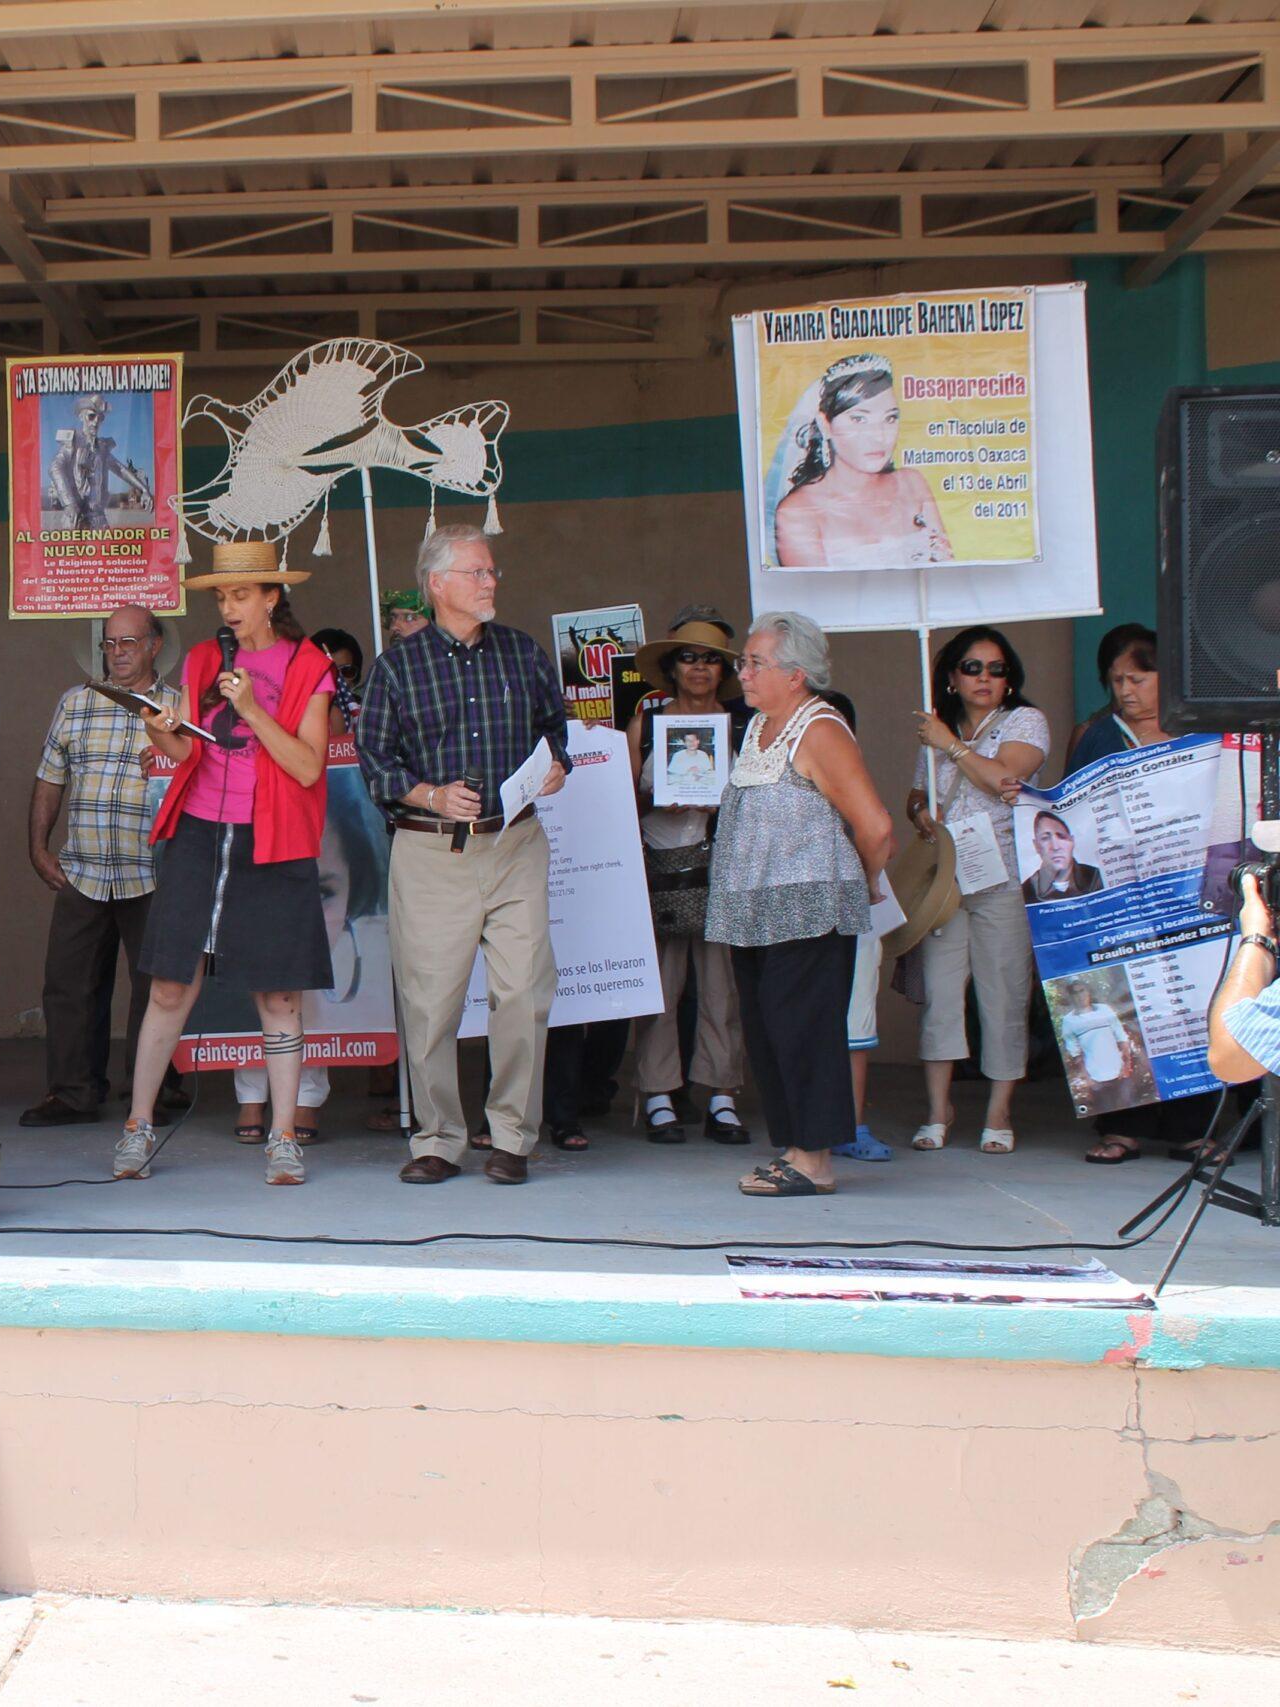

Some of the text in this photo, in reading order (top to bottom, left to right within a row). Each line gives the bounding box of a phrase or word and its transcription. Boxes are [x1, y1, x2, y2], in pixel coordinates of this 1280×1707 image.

[763, 298, 1025, 343] YAHAIRA GUADALUPE BAHENA LOPEZ
[37, 366, 80, 393] ESTAMOS
[82, 365, 114, 391] HASTA
[115, 365, 129, 390] LA
[130, 364, 170, 390] MADRE!!
[903, 373, 1026, 401] Desaparecida
[928, 418, 1026, 435] en Tlacolula de
[903, 447, 1026, 465] Matamoros Oaxaca
[943, 473, 1027, 491] el 13 de Abril
[974, 502, 1027, 518] del 2011
[15, 528, 170, 543] AL GOBERNADOR DE
[44, 544, 142, 557] NUEVO LEON
[58, 559, 104, 568] Exigimos
[98, 567, 144, 575] Problema
[23, 577, 38, 585] del
[149, 574, 169, 583] Hijo
[58, 585, 99, 593] Vaquero
[25, 594, 69, 602] realizado
[72, 594, 88, 602] por
[139, 592, 167, 600] Regia
[54, 602, 99, 610] Patrullas
[622, 670, 641, 683] Sin
[578, 684, 611, 699] maltr
[1091, 945, 1134, 963] Braulio
[556, 957, 646, 977] vos se los llevaron
[577, 980, 592, 994] los
[593, 976, 645, 994] queremos
